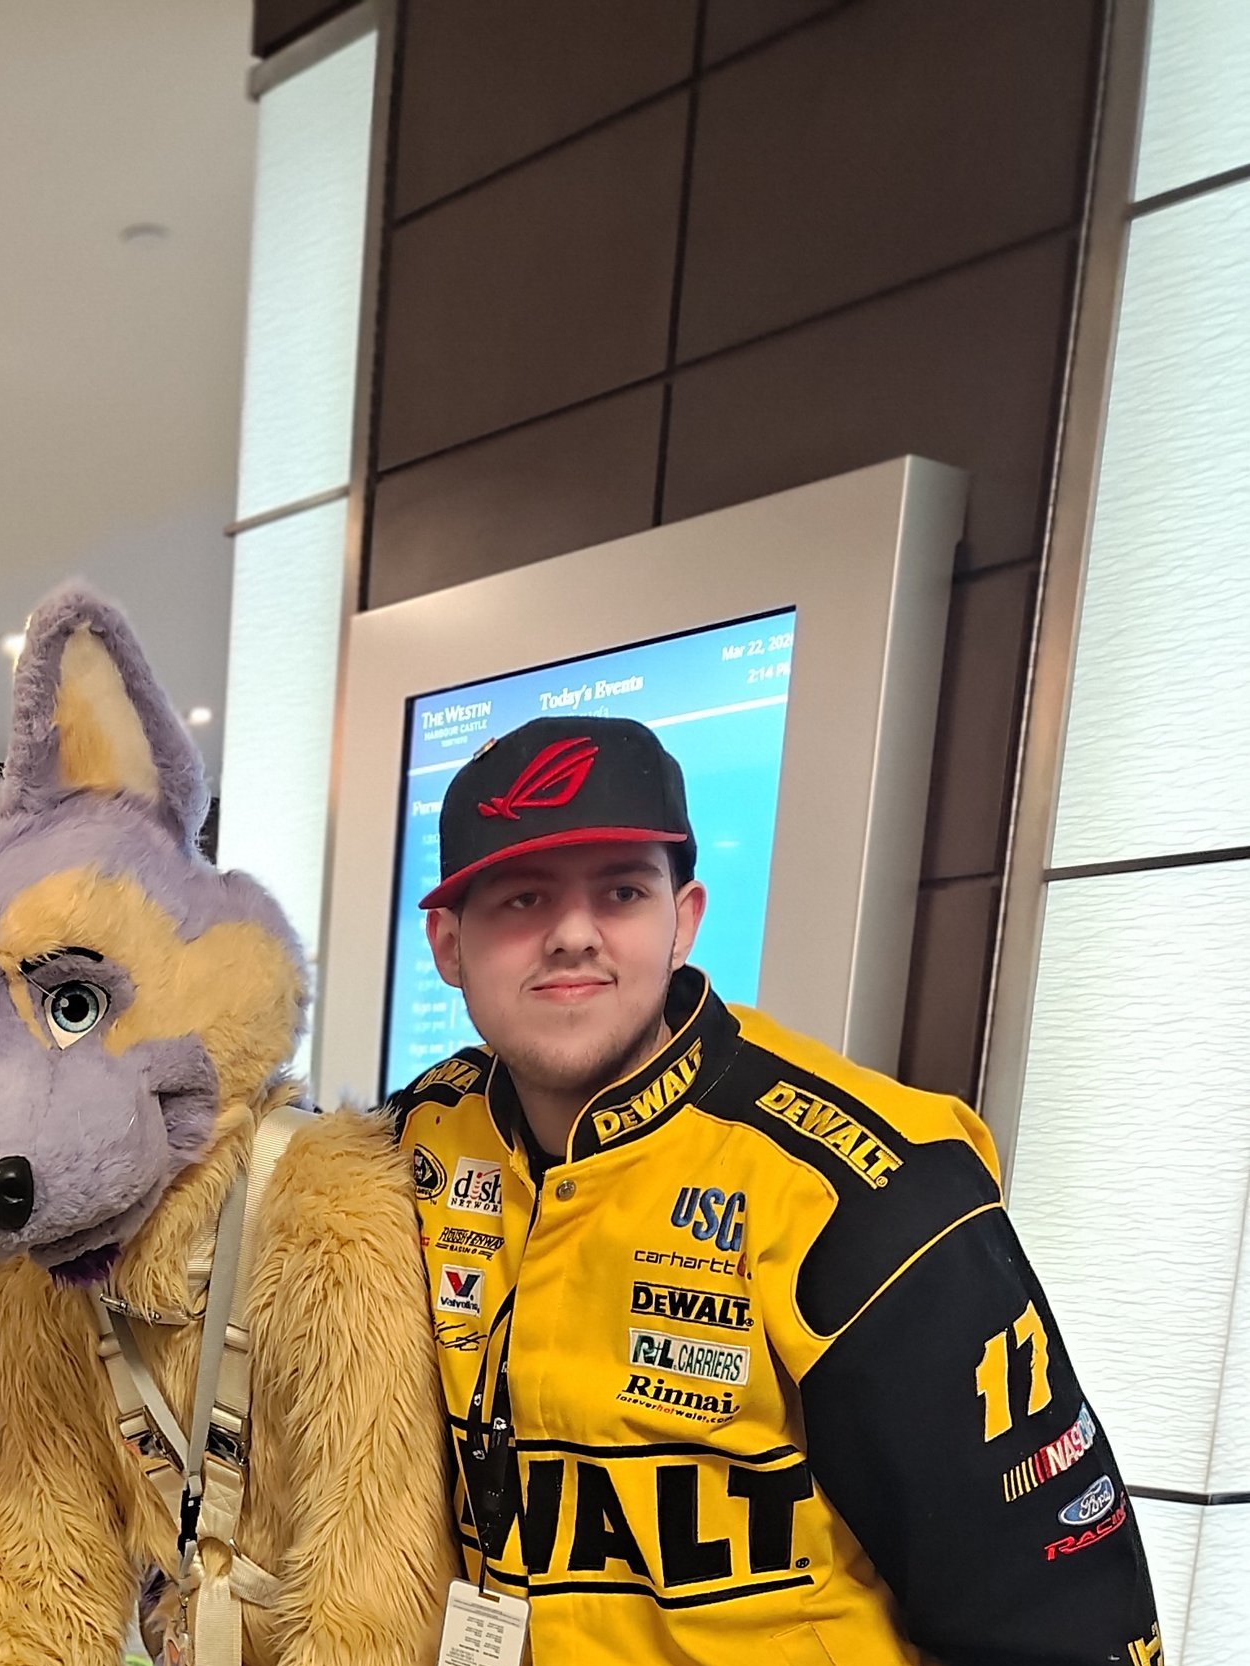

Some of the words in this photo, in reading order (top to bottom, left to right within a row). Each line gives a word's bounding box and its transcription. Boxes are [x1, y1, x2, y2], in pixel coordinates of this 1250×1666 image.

[722, 645, 745, 661] Mar
[747, 639, 765, 657] 22,
[768, 633, 795, 651] 202
[747, 664, 775, 684] 2:14
[540, 684, 592, 710] Today's
[594, 675, 644, 699] Events
[422, 711, 444, 729] THE
[445, 701, 492, 723] WESTIN
[460, 720, 488, 735] CASTLE
[758, 1083, 901, 1180] DEWALT
[454, 1170, 502, 1204] dish
[670, 1187, 746, 1252] USG
[634, 1250, 736, 1275] carhartt
[631, 1285, 750, 1327] DEWALT
[678, 1344, 743, 1382] CARRIERS
[976, 1300, 1052, 1442] 17
[622, 1374, 736, 1414] Rinnai
[460, 1450, 814, 1587] WALT
